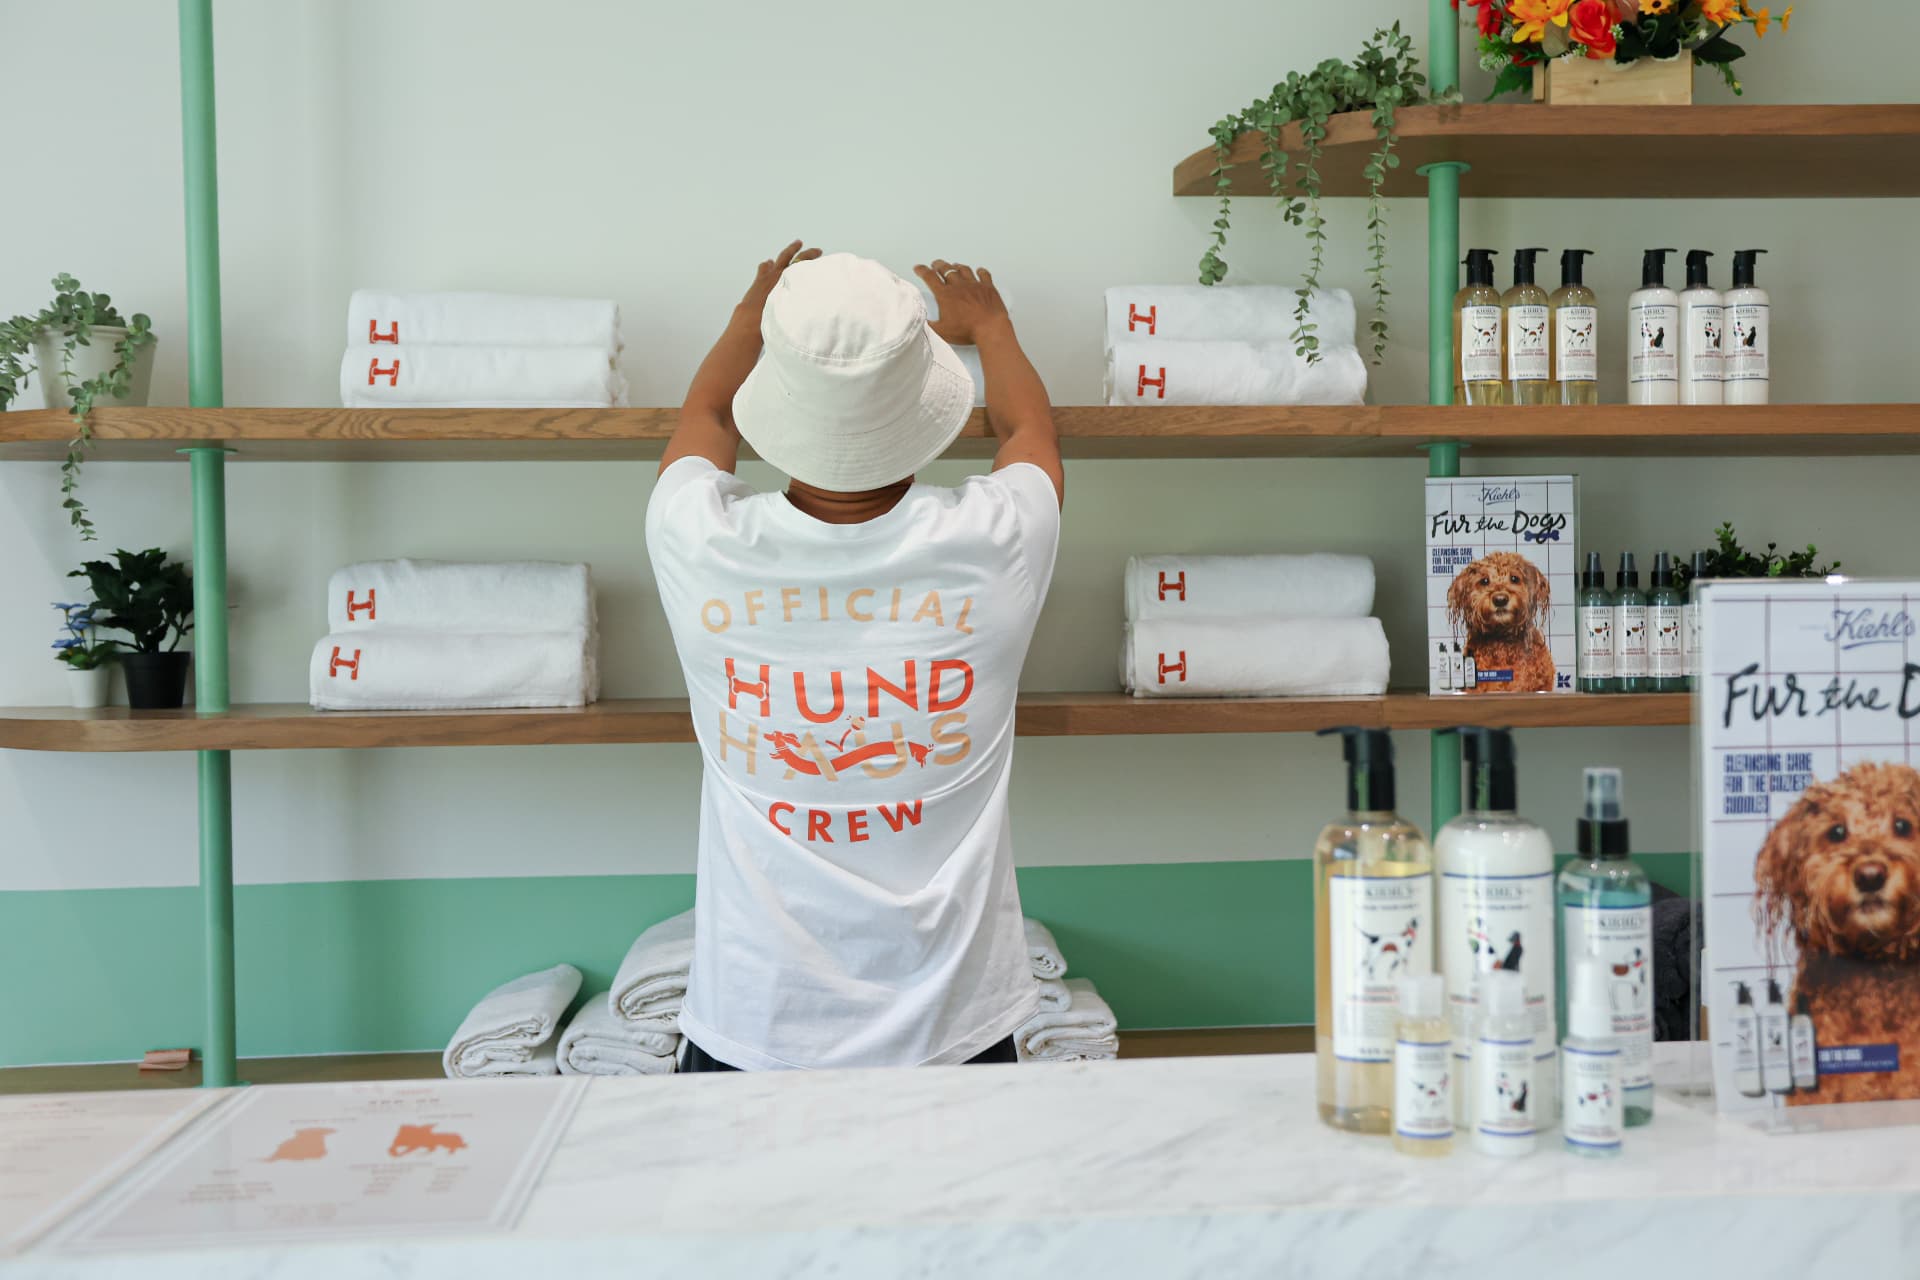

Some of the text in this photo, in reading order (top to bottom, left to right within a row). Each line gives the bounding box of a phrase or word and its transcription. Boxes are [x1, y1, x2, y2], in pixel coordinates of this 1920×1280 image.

[369, 319, 399, 344] H
[1128, 303, 1156, 335] H
[368, 358, 400, 387] H
[1137, 364, 1166, 399] H
[1478, 487, 1520, 505] Kiehl's
[1431, 510, 1566, 544] Fur the Dogs
[1158, 571, 1185, 601] H
[347, 588, 376, 621] H
[701, 586, 975, 634] OFFICIAL
[1824, 608, 1916, 650] Kiehl's
[329, 646, 361, 681] H
[1158, 650, 1187, 684] H
[724, 657, 974, 723] HUND
[1723, 662, 1808, 729] Fur
[1815, 677, 1890, 717] the
[719, 711, 972, 782] HAUS
[768, 799, 923, 843] CREW
